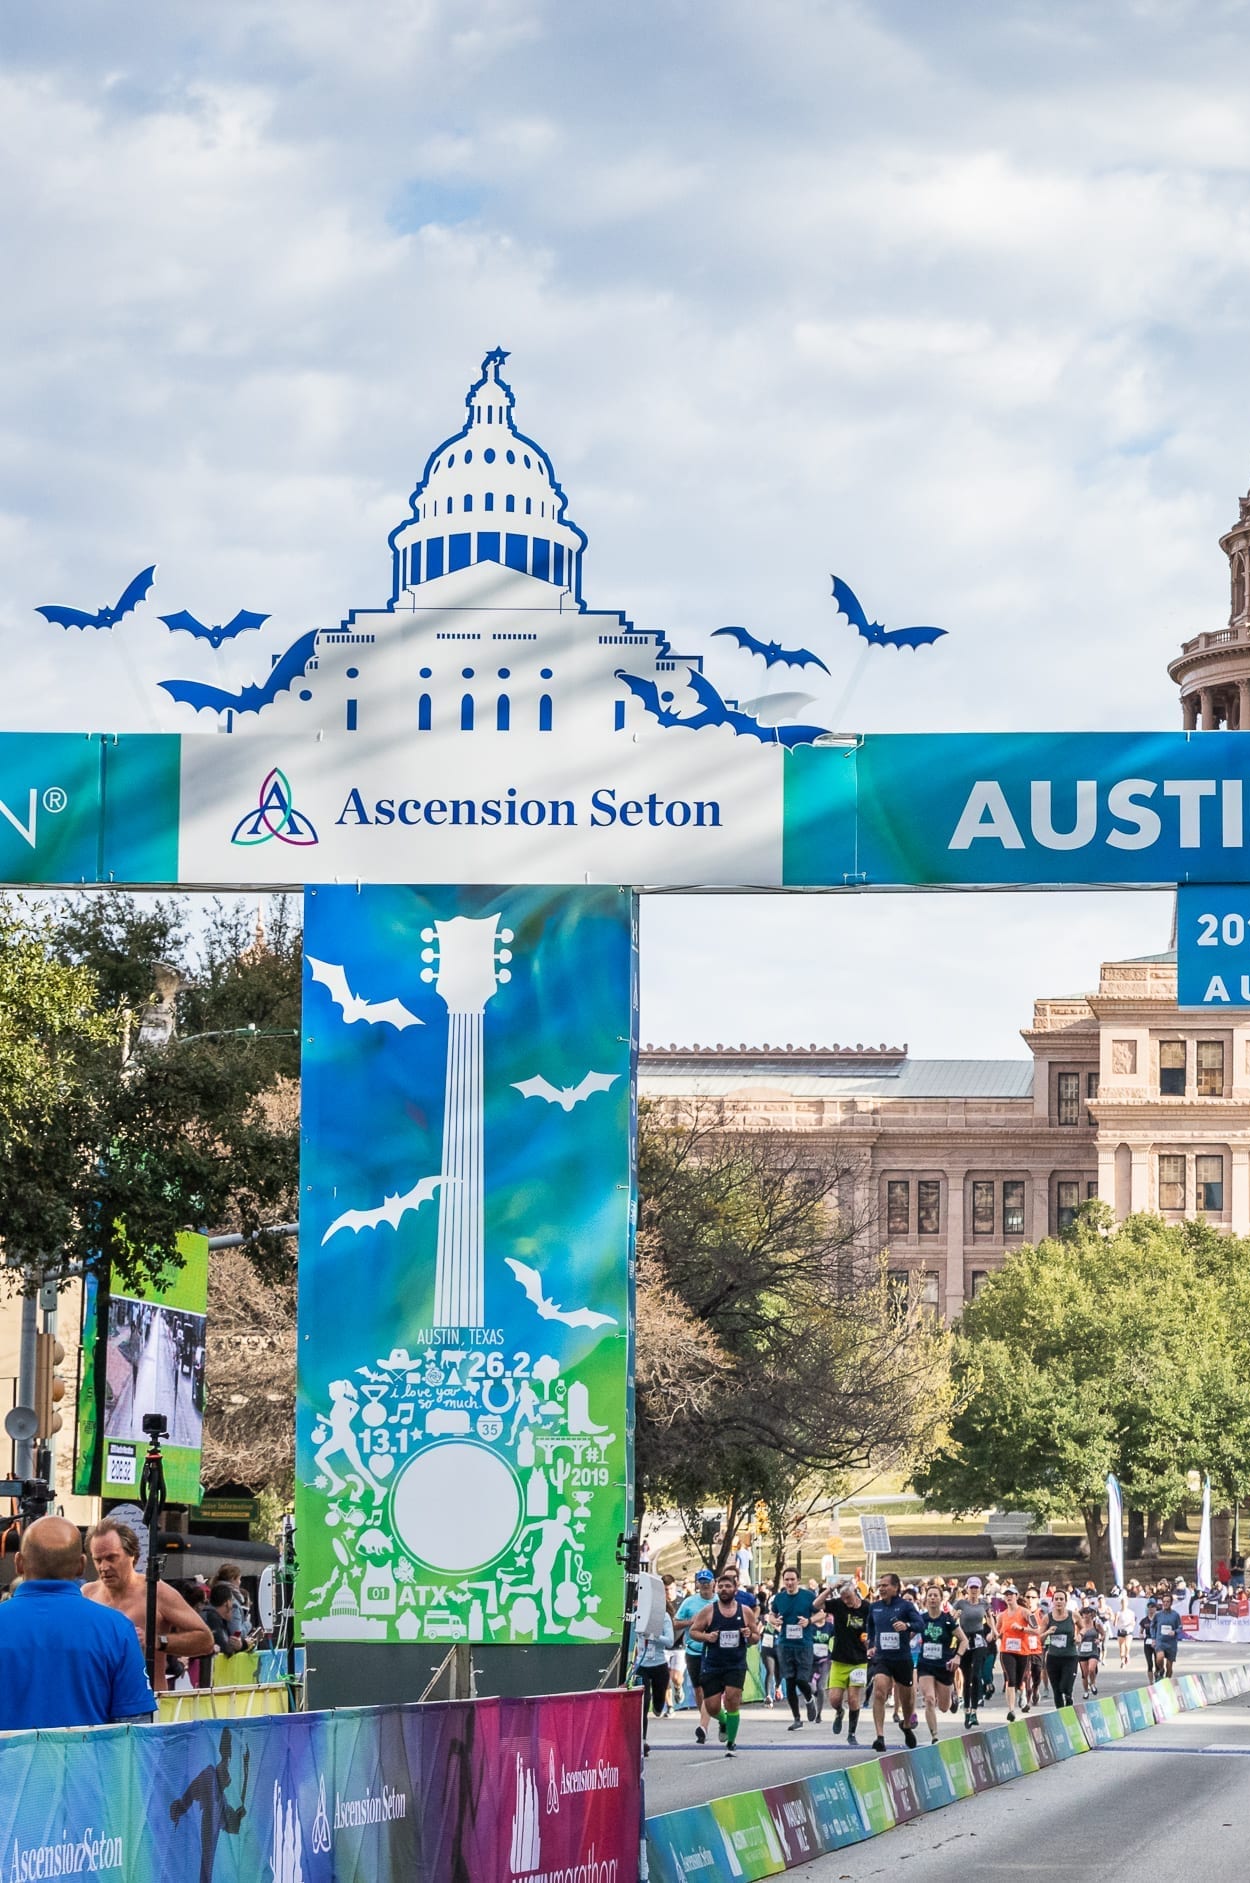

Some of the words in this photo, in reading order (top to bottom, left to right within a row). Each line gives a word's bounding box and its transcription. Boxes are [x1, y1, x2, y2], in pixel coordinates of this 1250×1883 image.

[335, 787, 575, 828] Ascension
[589, 789, 723, 828] Seton
[470, 1328, 504, 1345] TEXAS
[468, 1351, 531, 1378] 26.2
[401, 1383, 433, 1399] love
[418, 1399, 434, 1409] so
[358, 1428, 408, 1454] 13.1
[482, 1425, 498, 1436] 35
[571, 1468, 609, 1486] 2019
[372, 1587, 385, 1600] 01
[397, 1585, 448, 1606] ATX
[560, 1760, 597, 1795] Ascension
[597, 1758, 619, 1789] Seton
[334, 1787, 382, 1829] Ascension
[382, 1785, 406, 1820] Seton
[84, 1827, 123, 1872] Seton
